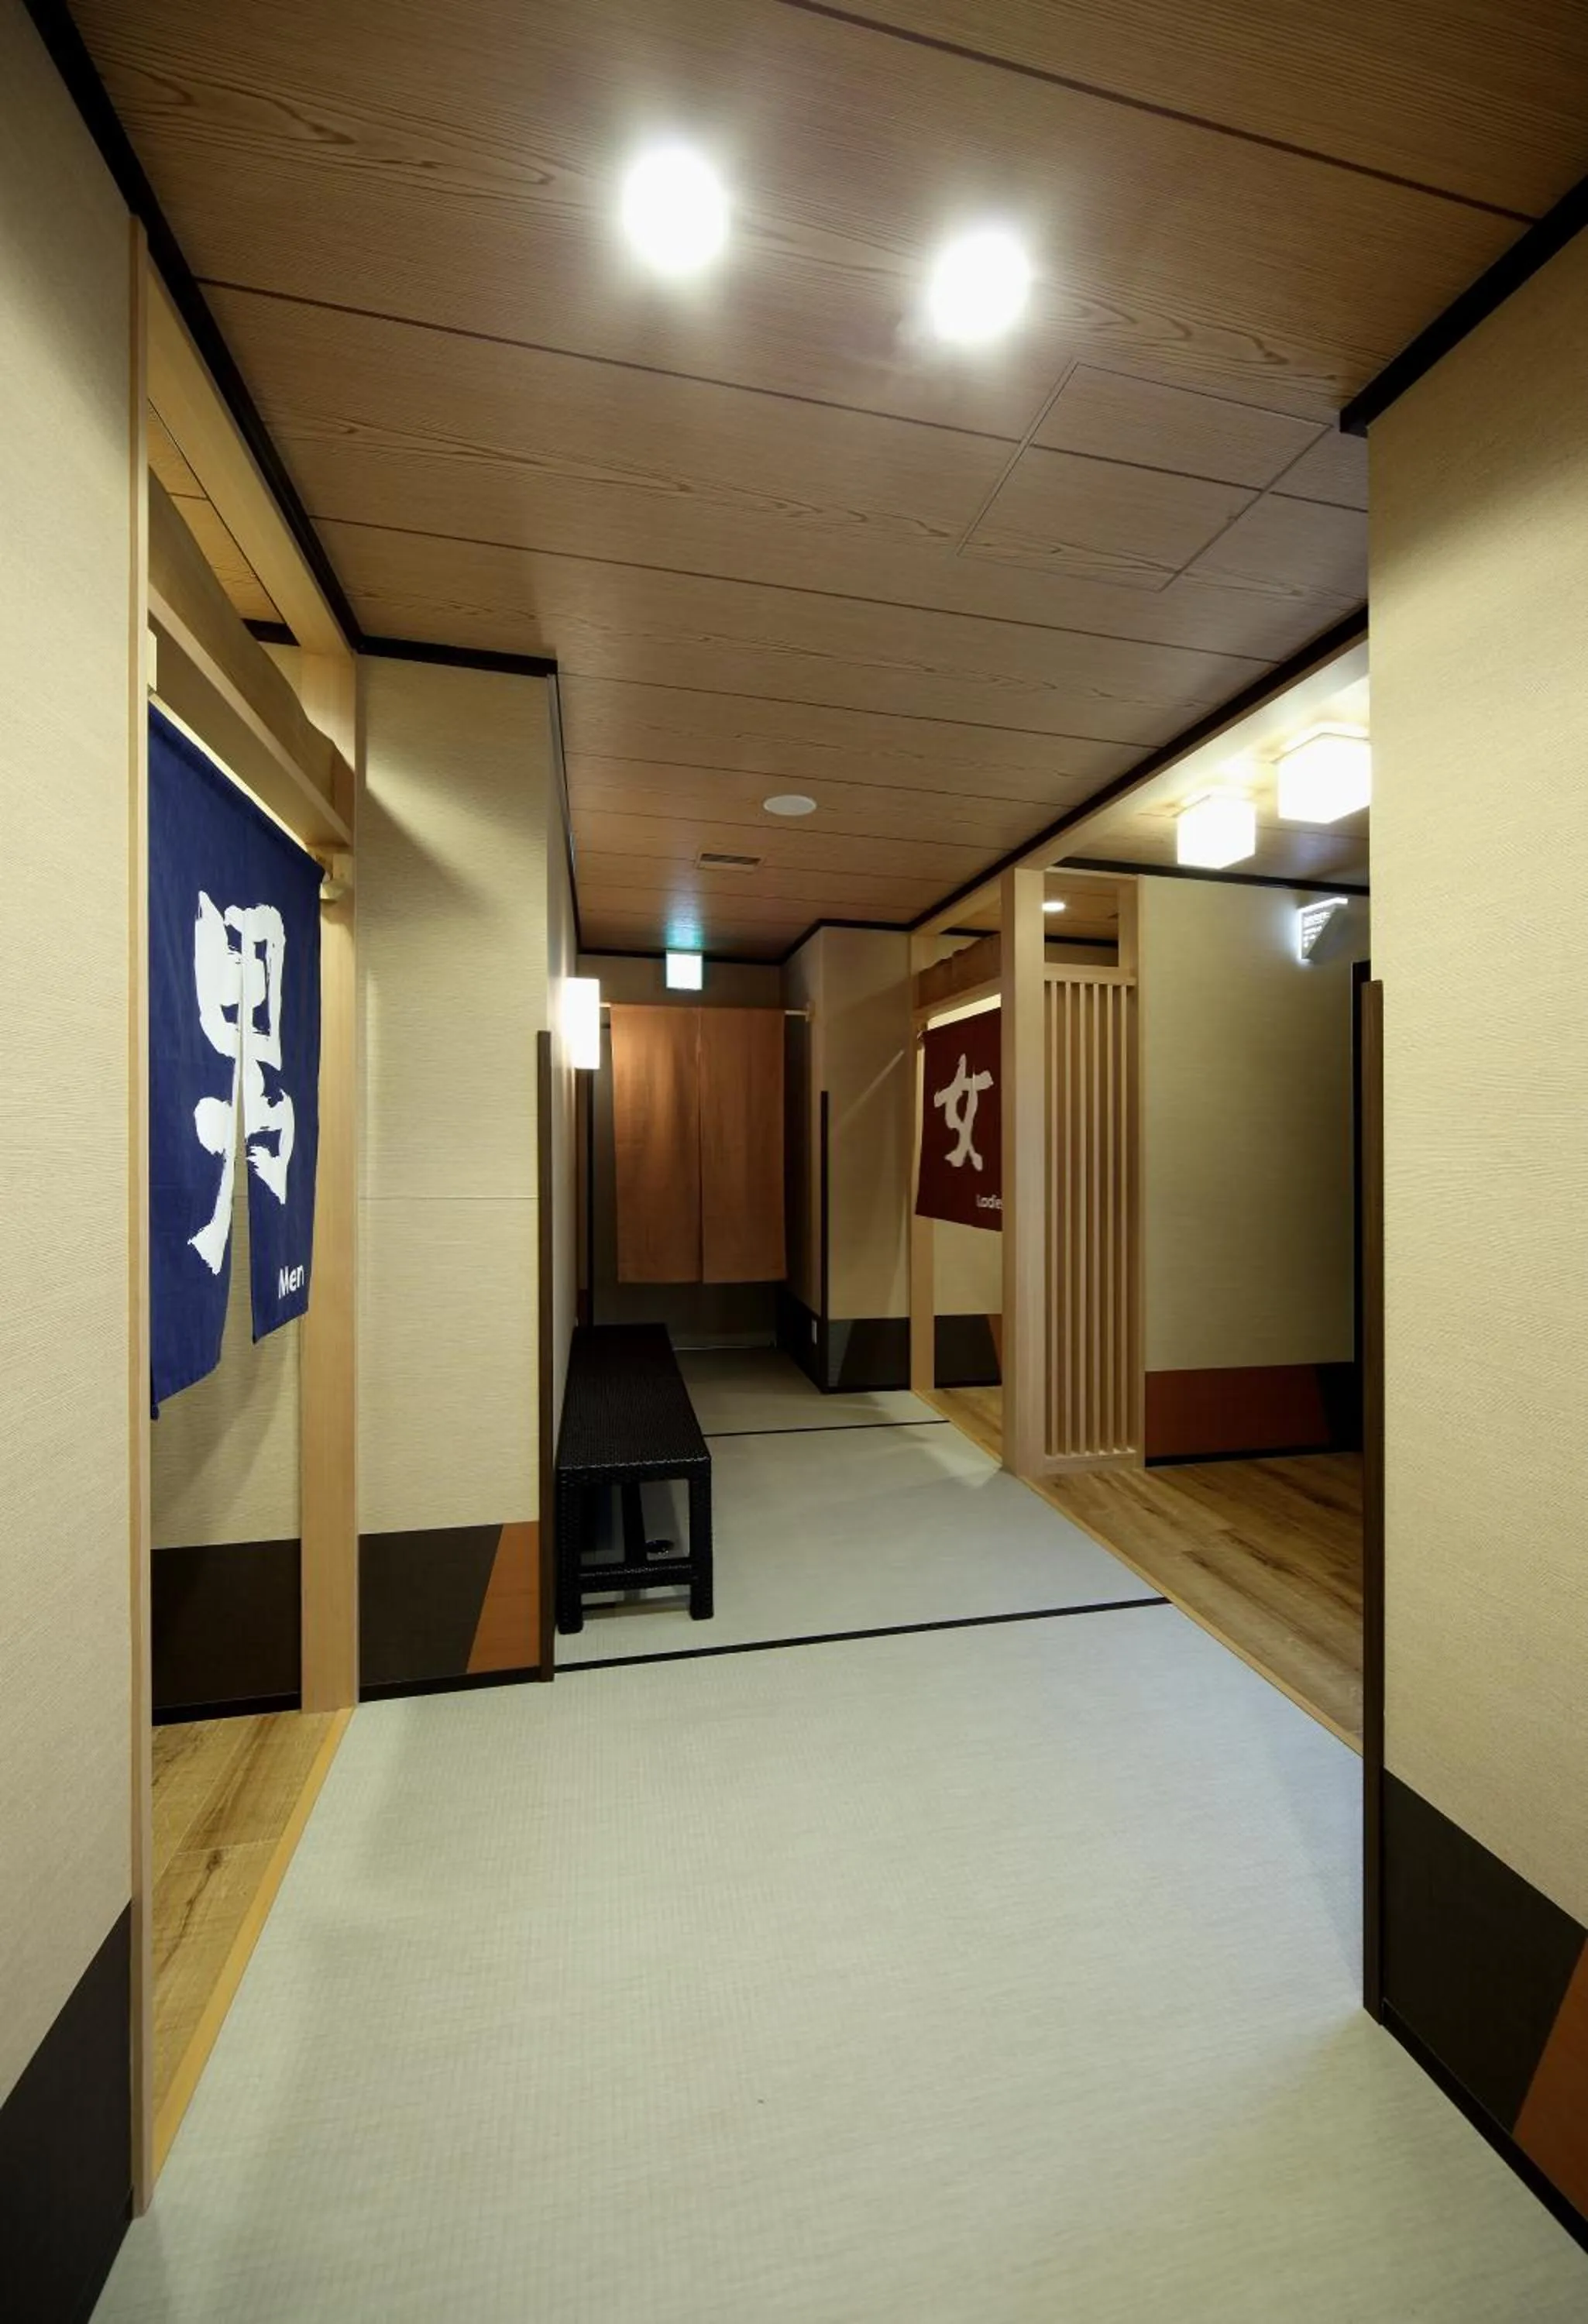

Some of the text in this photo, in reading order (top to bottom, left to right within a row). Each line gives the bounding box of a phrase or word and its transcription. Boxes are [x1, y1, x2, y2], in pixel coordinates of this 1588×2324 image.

[187, 890, 296, 1276] 男
[933, 1053, 994, 1172] 女
[976, 1194, 1002, 1209] Ladie
[278, 1265, 304, 1300] Men
